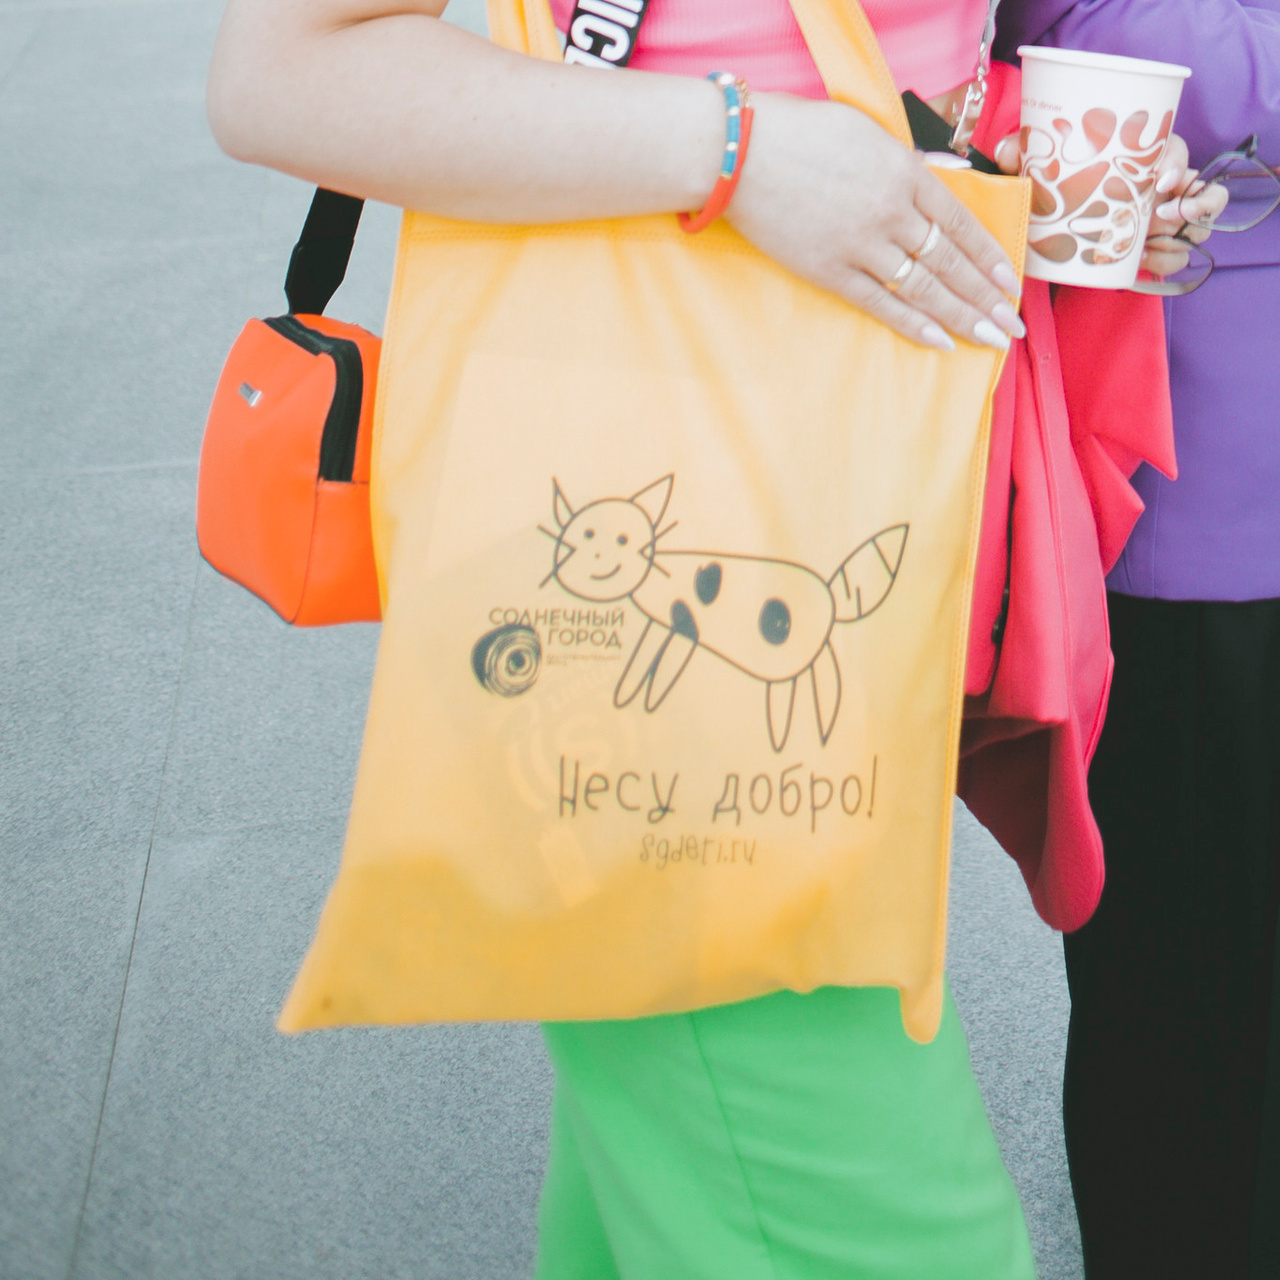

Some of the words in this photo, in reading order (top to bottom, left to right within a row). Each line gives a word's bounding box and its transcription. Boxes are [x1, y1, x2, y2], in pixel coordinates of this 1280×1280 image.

[489, 606, 625, 628] СОЛНЕЧНЫЙ
[547, 627, 622, 650] ГОРОД
[559, 755, 679, 824] Несу
[712, 754, 878, 834] добро!
